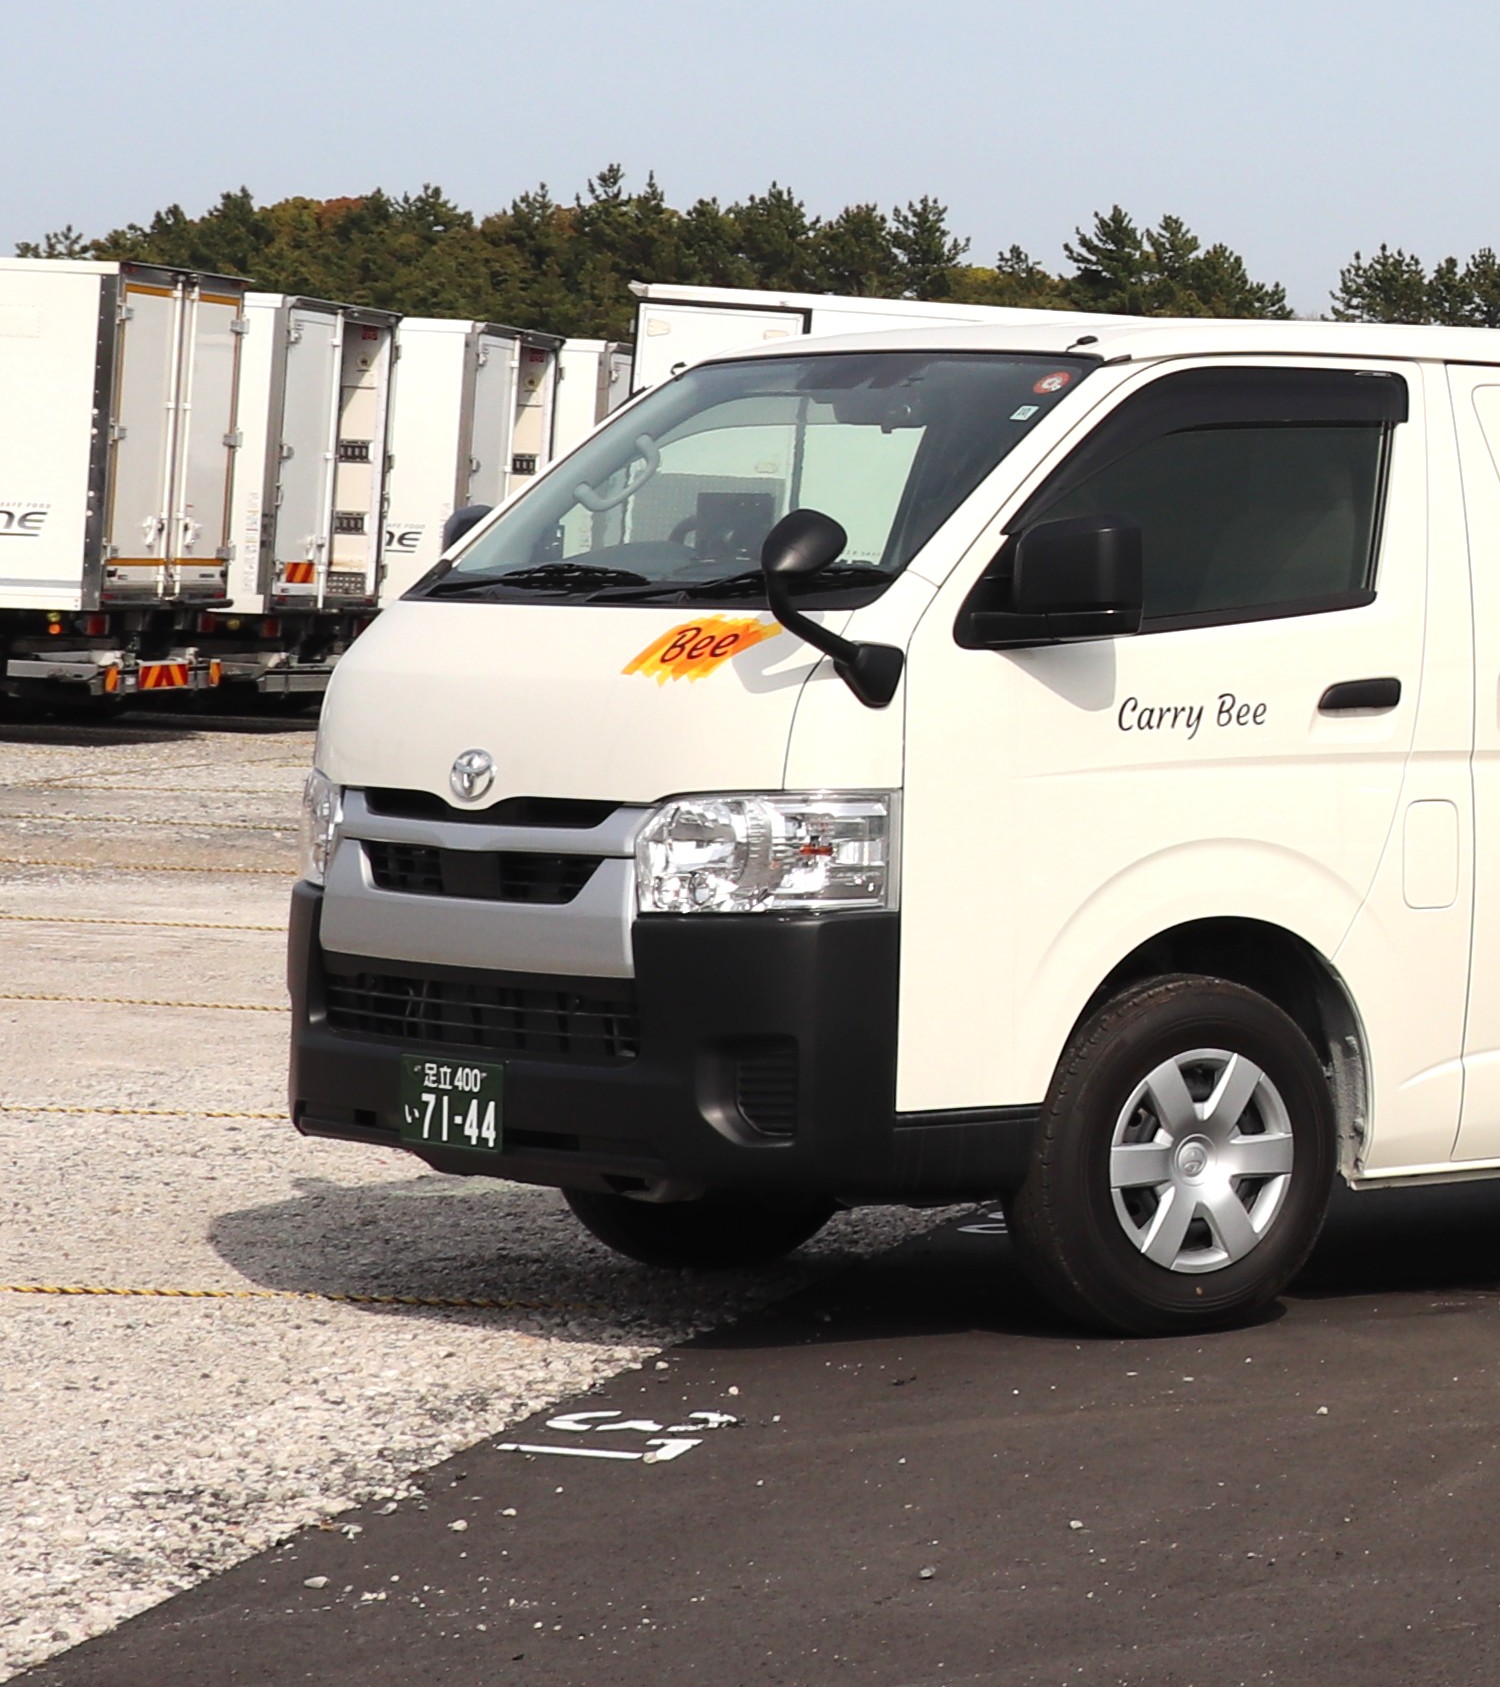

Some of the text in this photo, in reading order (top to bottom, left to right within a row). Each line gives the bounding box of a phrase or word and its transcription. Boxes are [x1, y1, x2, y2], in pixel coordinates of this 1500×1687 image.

[660, 626, 740, 664] Bee
[1118, 693, 1267, 741] Carry Bee
[404, 1092, 497, 1148] い 71-44
